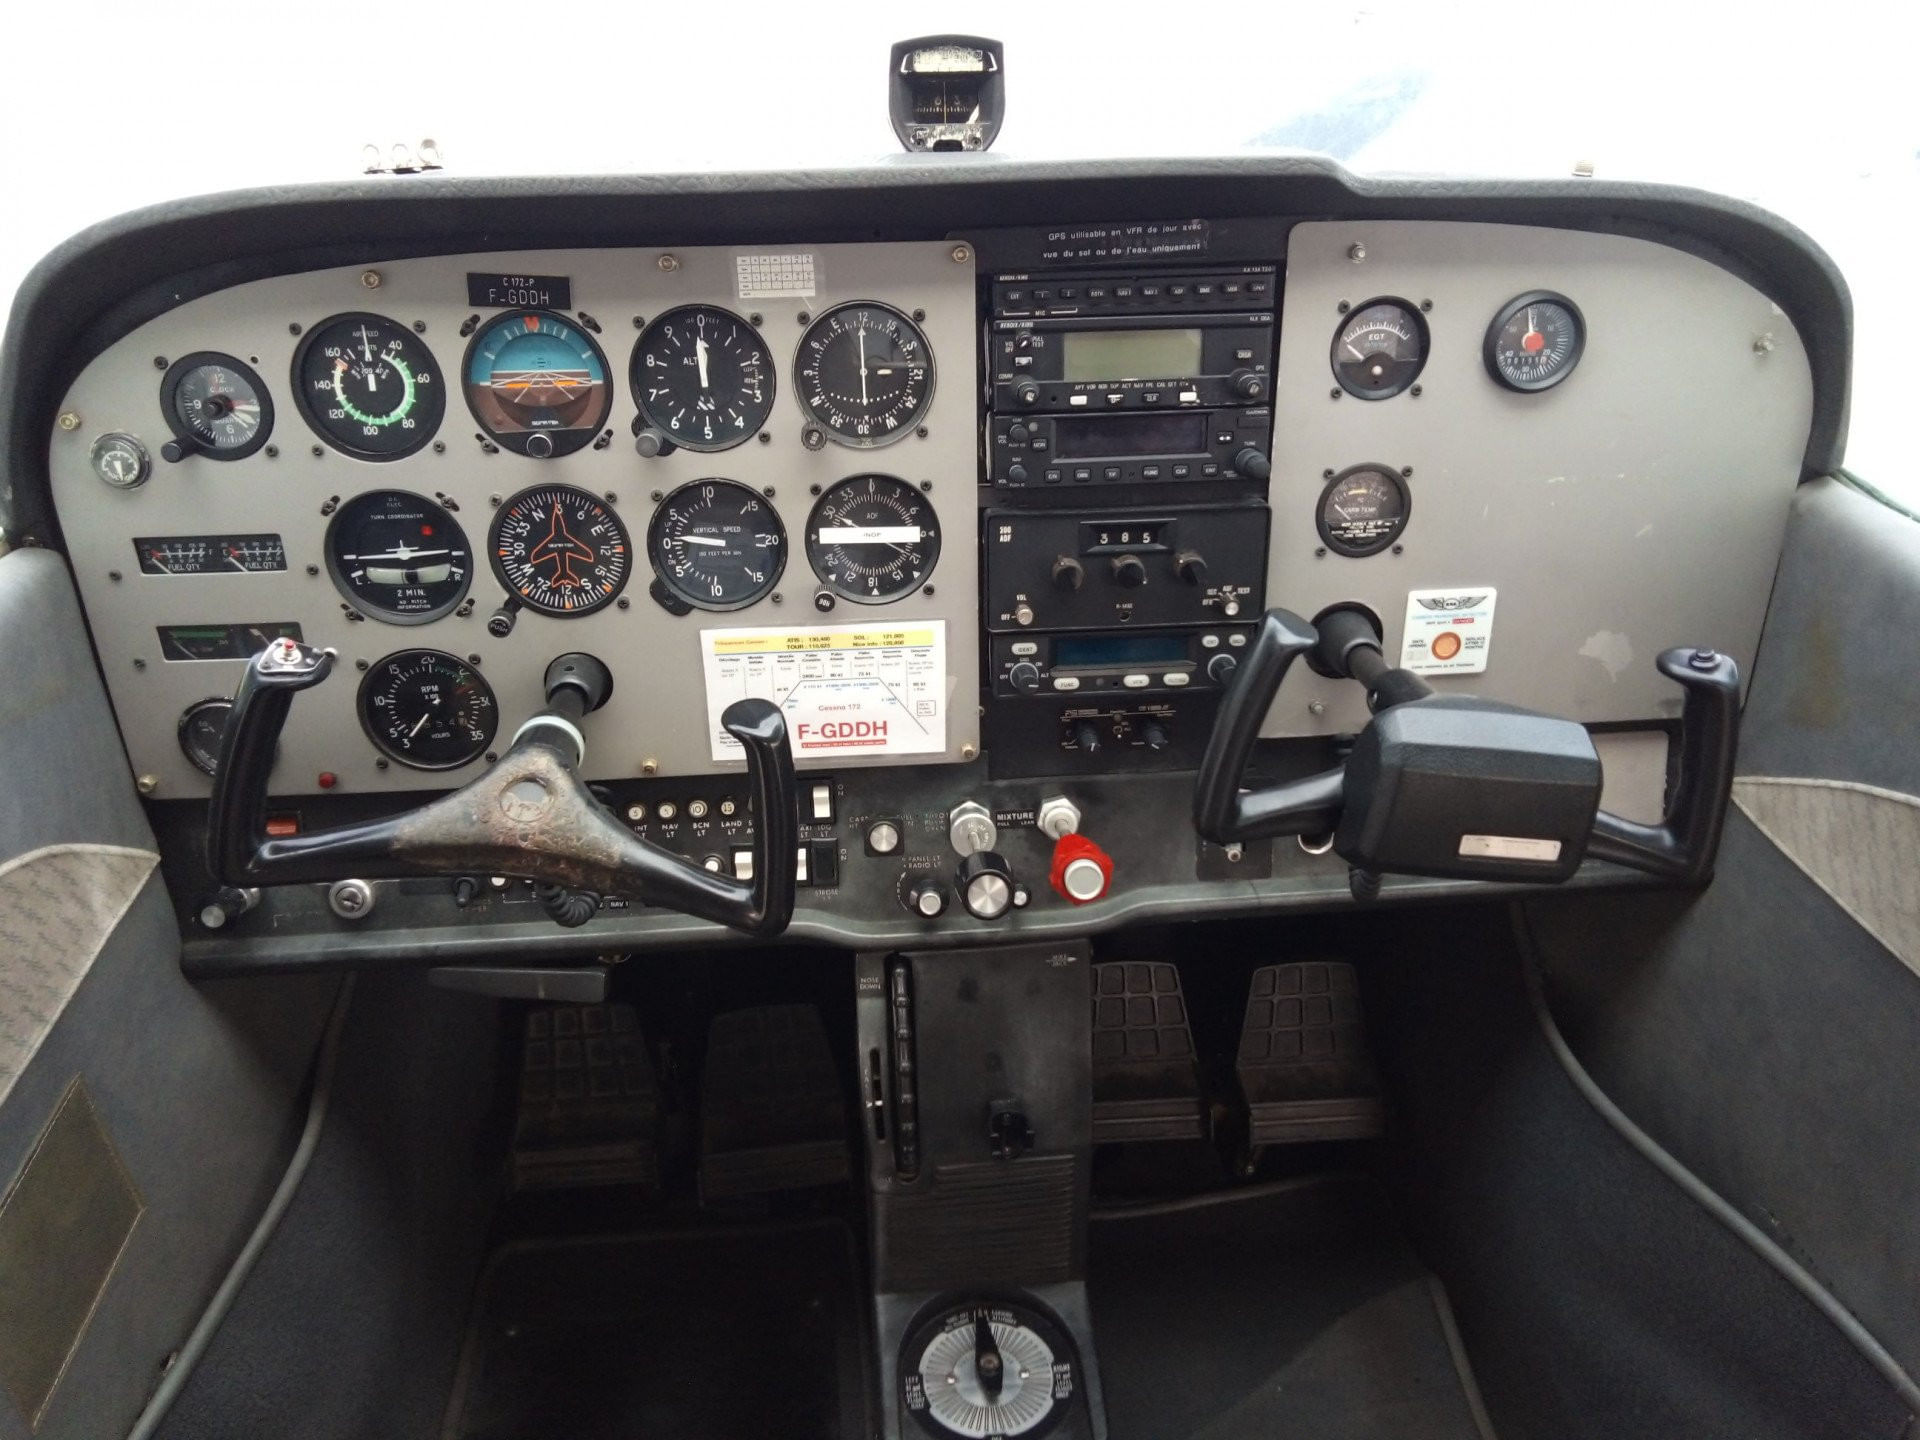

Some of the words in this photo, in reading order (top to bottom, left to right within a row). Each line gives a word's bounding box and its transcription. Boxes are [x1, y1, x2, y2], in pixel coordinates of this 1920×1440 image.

[1049, 232, 1066, 241] GPS
[1070, 230, 1106, 239] utilisable
[1126, 227, 1142, 235] VFR
[1148, 225, 1157, 233] de
[1162, 225, 1177, 234] jour
[1183, 223, 1202, 231] avec
[1078, 249, 1091, 257] sol
[1152, 243, 1201, 252] uniquement
[503, 277, 509, 286] C
[696, 314, 705, 327] 0
[857, 312, 869, 322] 12
[830, 317, 840, 330] E
[663, 325, 673, 339] 9
[1368, 333, 1385, 341] EGT
[388, 340, 403, 351] 40
[906, 341, 918, 351] S
[324, 347, 341, 358] 160
[646, 354, 655, 367] 8
[682, 356, 698, 366] ALT
[751, 352, 761, 365] 2
[214, 373, 226, 384] 12
[417, 373, 430, 383] 60
[803, 369, 813, 377] 3
[913, 369, 924, 381] 21
[314, 380, 331, 390] 140
[648, 388, 657, 402] 7
[753, 390, 763, 403] 3
[193, 399, 202, 410] 9
[810, 395, 822, 408] N
[905, 396, 917, 409] 24
[328, 408, 345, 419] 120
[402, 418, 415, 429] 80
[670, 416, 680, 430] 6
[734, 416, 745, 429] 4
[885, 416, 898, 430] W
[225, 424, 235, 434] 6
[362, 426, 379, 436] 100
[704, 426, 713, 440] 5
[857, 424, 870, 435] 30
[702, 486, 714, 498] 10
[840, 487, 854, 502] 33
[892, 487, 901, 498] 3
[747, 500, 759, 512] 15
[909, 506, 920, 515] 6
[531, 507, 546, 522] N
[577, 510, 586, 521] 6
[669, 508, 678, 521] 5
[822, 505, 836, 520] 30
[515, 521, 531, 537] 33
[590, 524, 605, 537] E
[764, 534, 779, 546] 20
[999, 534, 1012, 542] ADF
[513, 542, 526, 557] 30
[663, 538, 672, 550] 0
[600, 545, 612, 556] 12
[824, 553, 839, 567] 24
[908, 553, 922, 565] 12
[167, 563, 185, 571] FUEL
[519, 563, 536, 577] W
[594, 564, 608, 578] 15
[675, 565, 684, 578] 5
[752, 571, 764, 583] 15
[844, 570, 857, 583] 21
[892, 570, 904, 581] 15
[355, 577, 363, 586] L
[536, 576, 551, 591] 24
[580, 578, 593, 591] S
[867, 576, 879, 587] 18
[397, 589, 403, 597] 2
[561, 584, 573, 595] 21
[711, 585, 723, 597] 10
[388, 663, 400, 675] 15
[420, 684, 439, 694] RPM
[374, 695, 385, 706] 10
[818, 704, 846, 712] Cessna
[389, 727, 398, 738] 5
[469, 730, 484, 741] 35
[797, 720, 888, 740] F-GDDH
[401, 738, 411, 749] 3
[723, 803, 732, 813] 15
[996, 811, 1034, 821] MIXTURE
[720, 820, 742, 828] LAND
[697, 829, 706, 837] LT
[727, 828, 736, 836] LT
